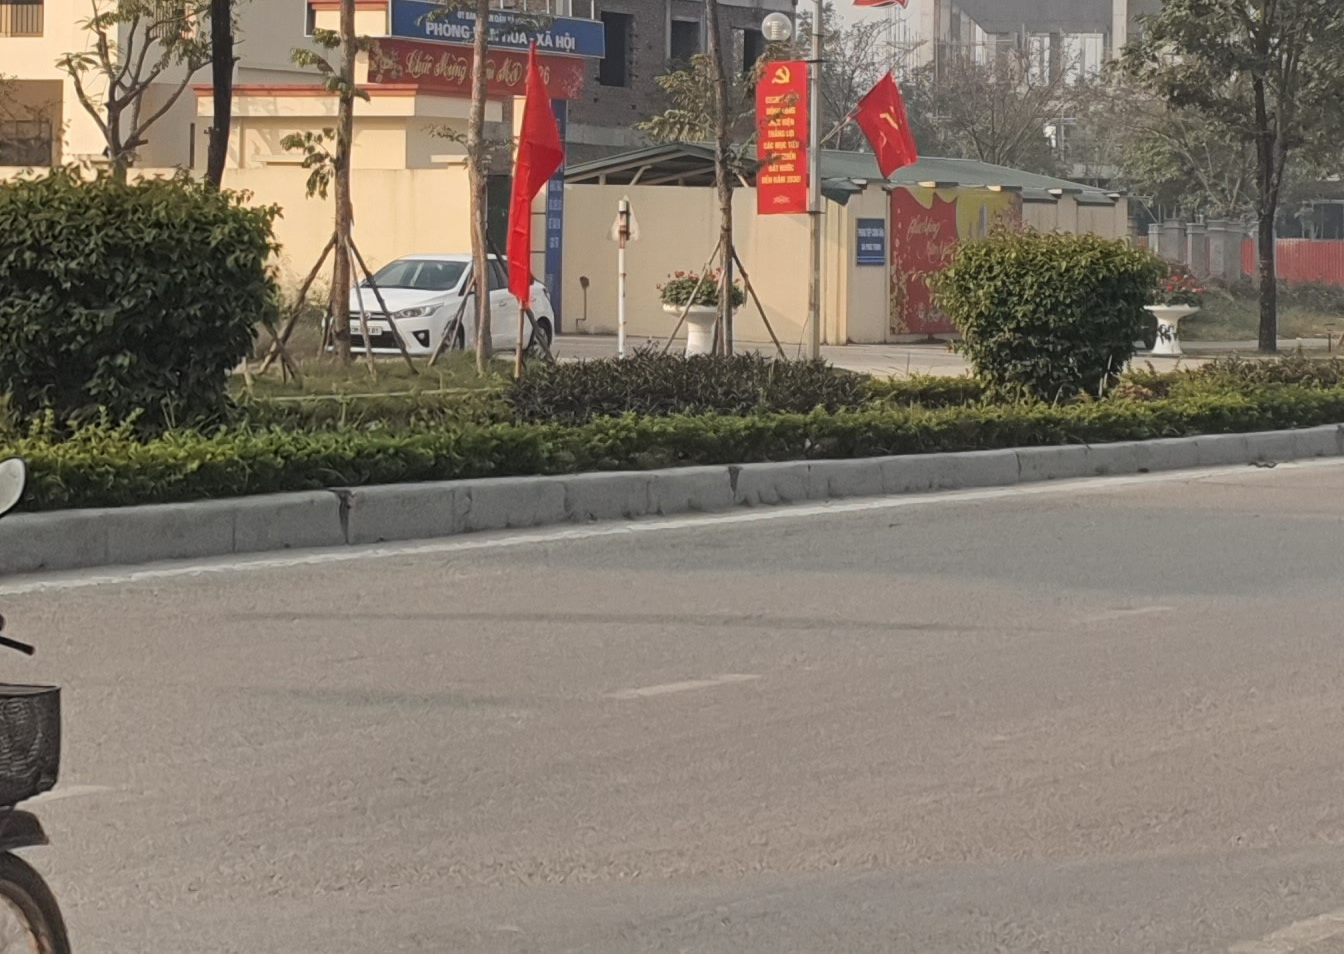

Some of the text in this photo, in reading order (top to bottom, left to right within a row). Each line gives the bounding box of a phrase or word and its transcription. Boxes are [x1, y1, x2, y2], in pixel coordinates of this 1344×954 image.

[425, 19, 470, 39] PHÒNG
[536, 30, 553, 48] XÃ
[556, 32, 575, 51] HỘI
